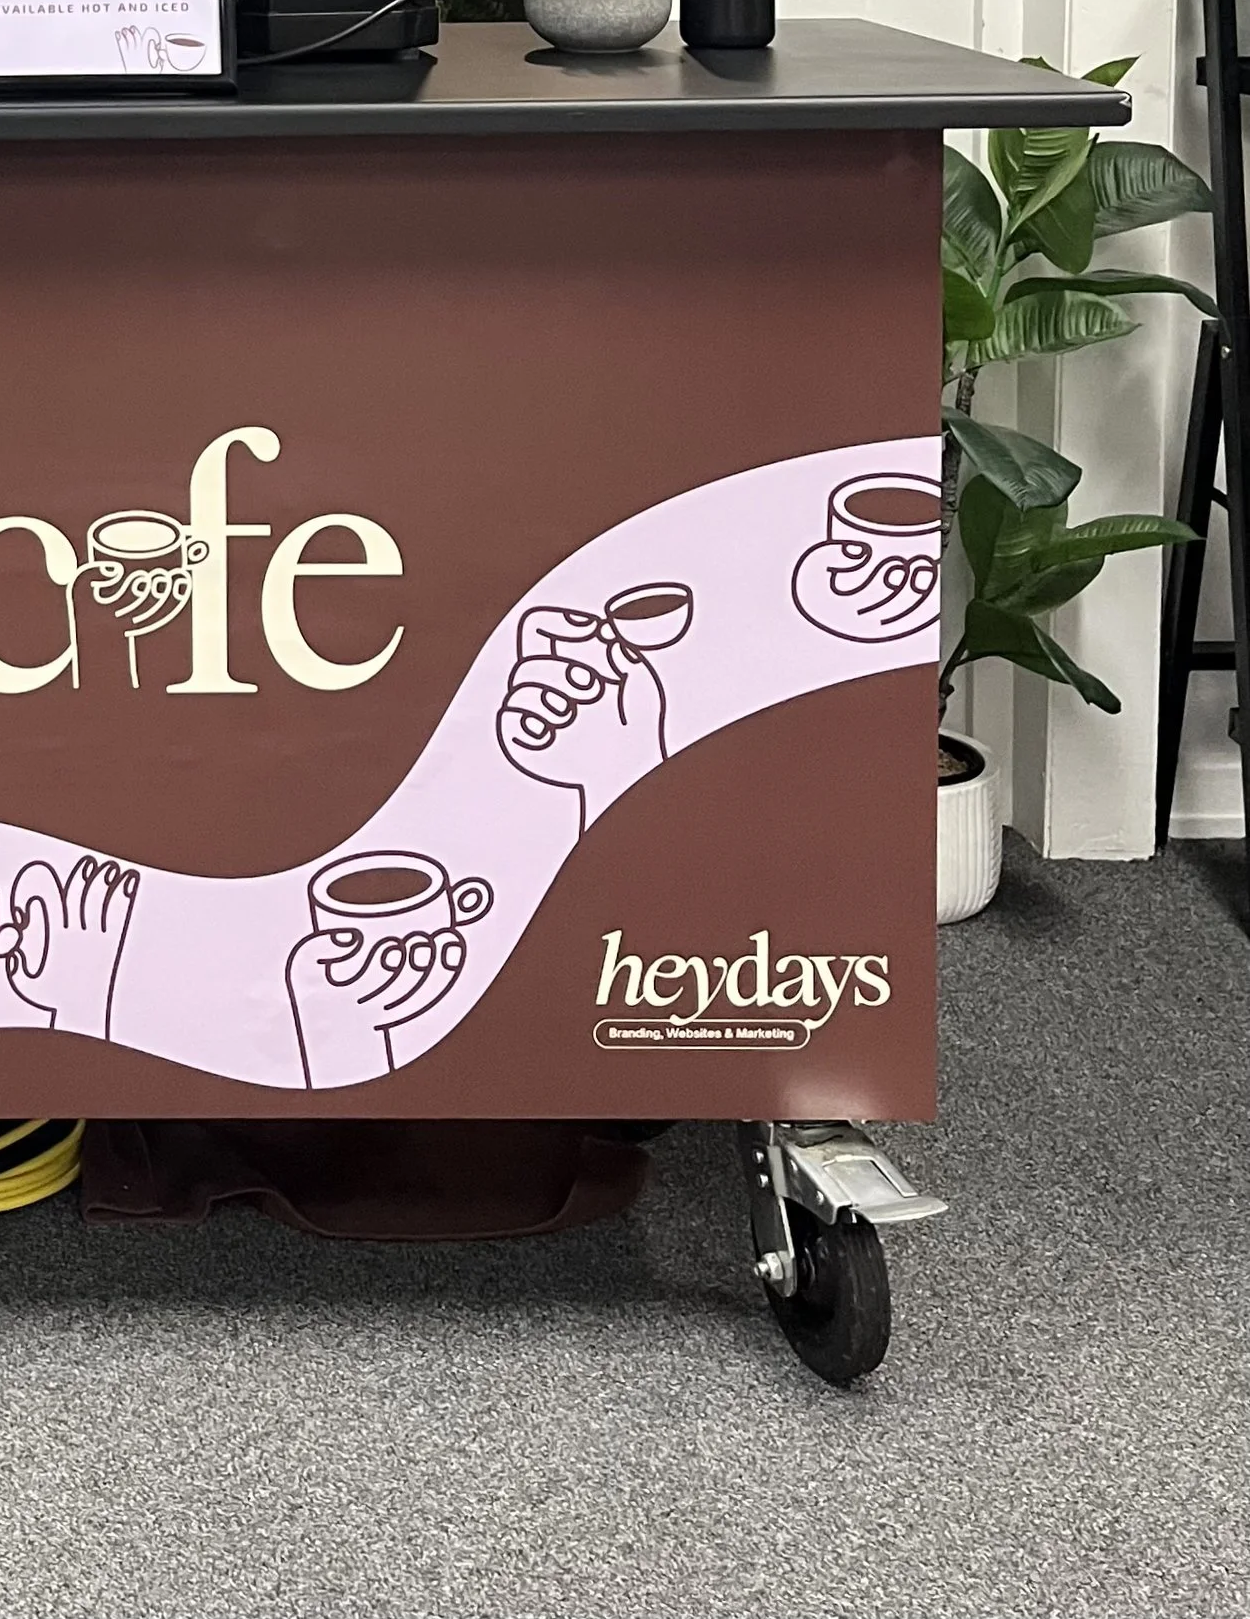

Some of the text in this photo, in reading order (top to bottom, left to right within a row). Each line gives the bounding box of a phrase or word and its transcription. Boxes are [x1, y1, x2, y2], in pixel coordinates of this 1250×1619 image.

[81, 3, 110, 13] HOT
[117, 2, 148, 12] AND
[155, 2, 190, 12] ICED
[595, 929, 891, 1030] heydays
[609, 1027, 795, 1041] Branding, Websites & Marketing
